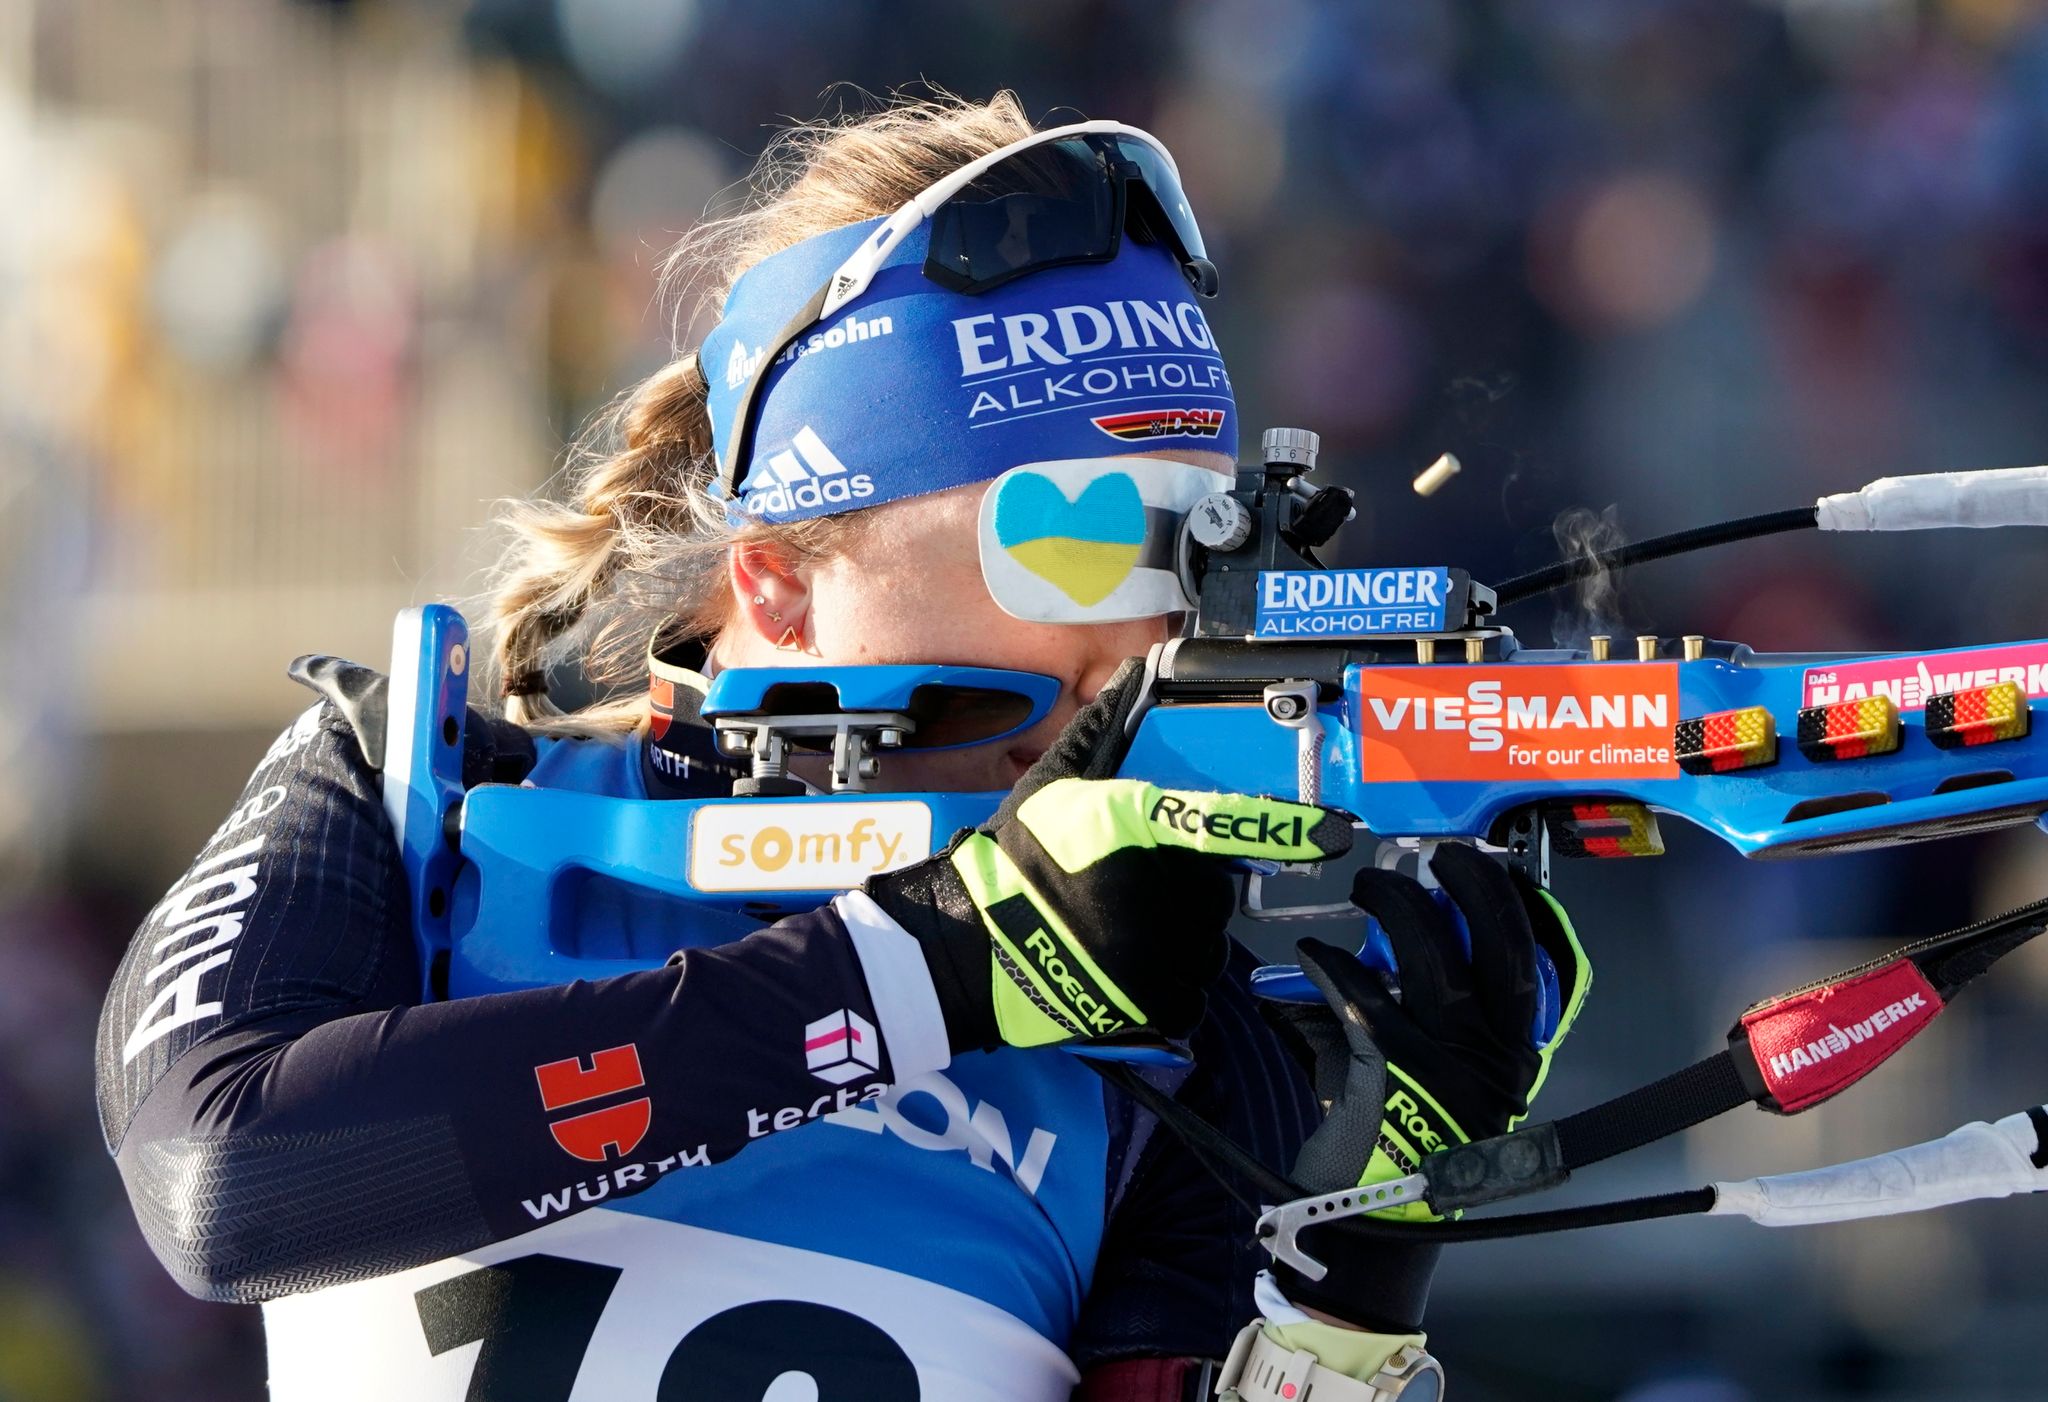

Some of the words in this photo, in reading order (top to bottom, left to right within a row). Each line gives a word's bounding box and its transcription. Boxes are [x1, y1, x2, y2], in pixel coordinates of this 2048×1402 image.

[1166, 409, 1225, 438] DSV
[748, 474, 874, 514] adidas
[1262, 569, 1441, 612] ERDINGER
[1261, 611, 1436, 634] ALKOHOLFREI
[1808, 672, 1837, 685] DAS
[1368, 680, 1668, 752] VIESSMANN
[1508, 744, 1541, 765] for
[1547, 748, 1584, 764] our
[1589, 743, 1670, 764] climate
[122, 834, 266, 1067] Audi
